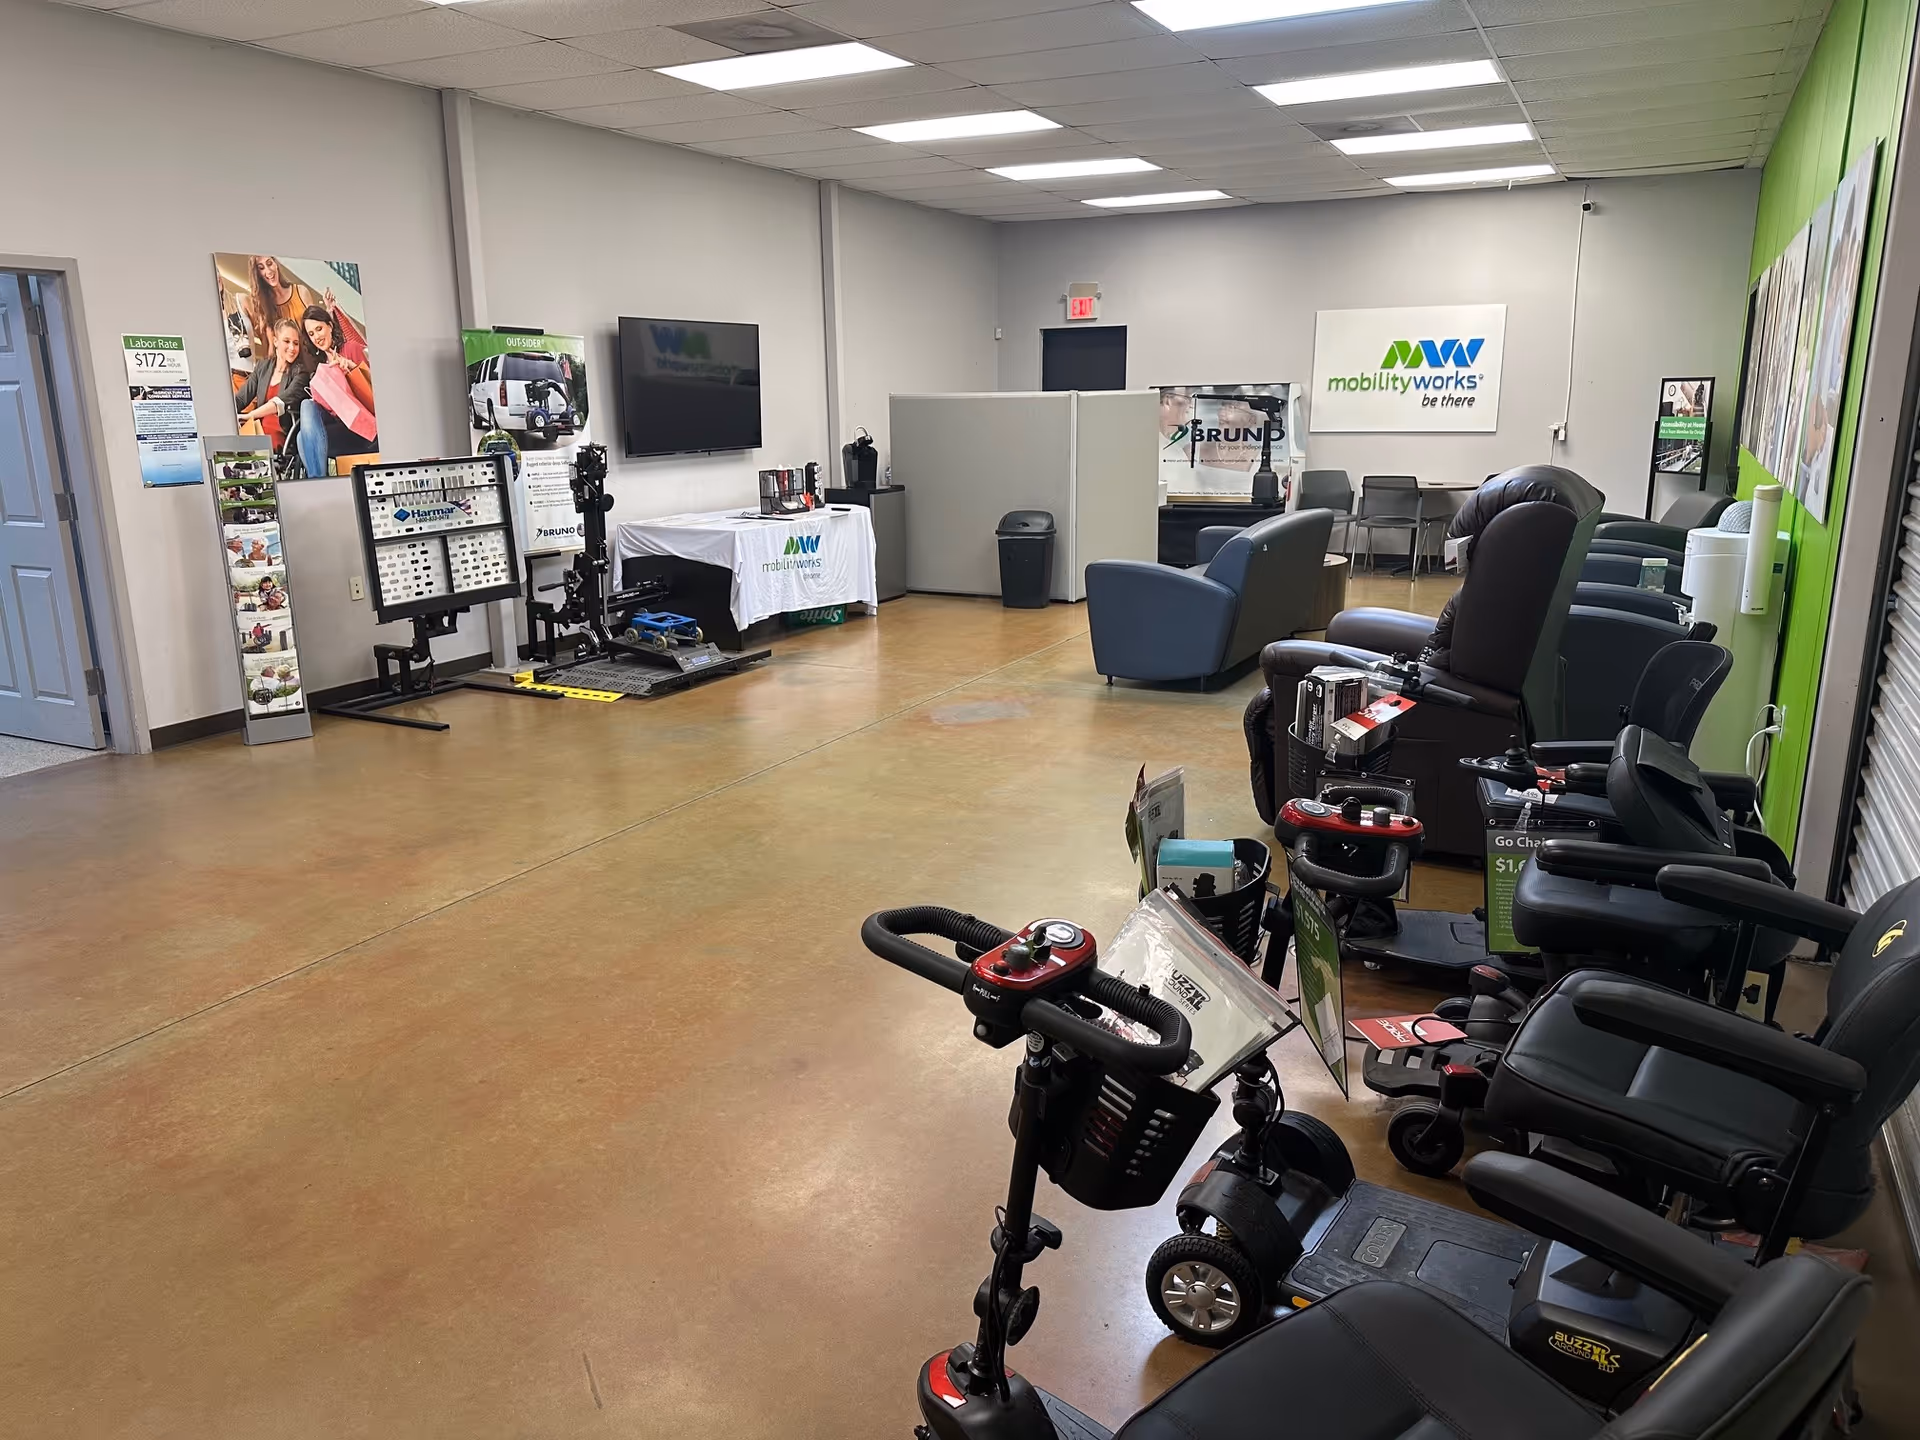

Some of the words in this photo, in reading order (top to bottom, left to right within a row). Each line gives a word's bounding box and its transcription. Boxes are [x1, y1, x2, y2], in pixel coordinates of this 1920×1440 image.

[1072, 298, 1093, 317] EXIT
[129, 338, 156, 348] Labor
[158, 339, 178, 349] Rate
[134, 352, 167, 367] $172
[1327, 371, 1480, 394] mobilityworks
[1421, 394, 1438, 407] be
[1441, 394, 1476, 407] there
[1243, 443, 1283, 451] indepence
[411, 507, 456, 518] Harmar
[543, 526, 576, 537] BRUNO
[800, 606, 842, 623] Sprite
[1495, 836, 1514, 848] Go
[1517, 835, 1548, 848] Chai
[1179, 997, 1197, 1015] SERIES
[1186, 989, 1206, 1012] XL
[1376, 1019, 1410, 1042] PRIDE
[1362, 1224, 1400, 1264] GOLDEN
[1554, 1341, 1591, 1359] AROUND
[1555, 1331, 1592, 1352] BUZZ
[1598, 1362, 1615, 1373] HD
